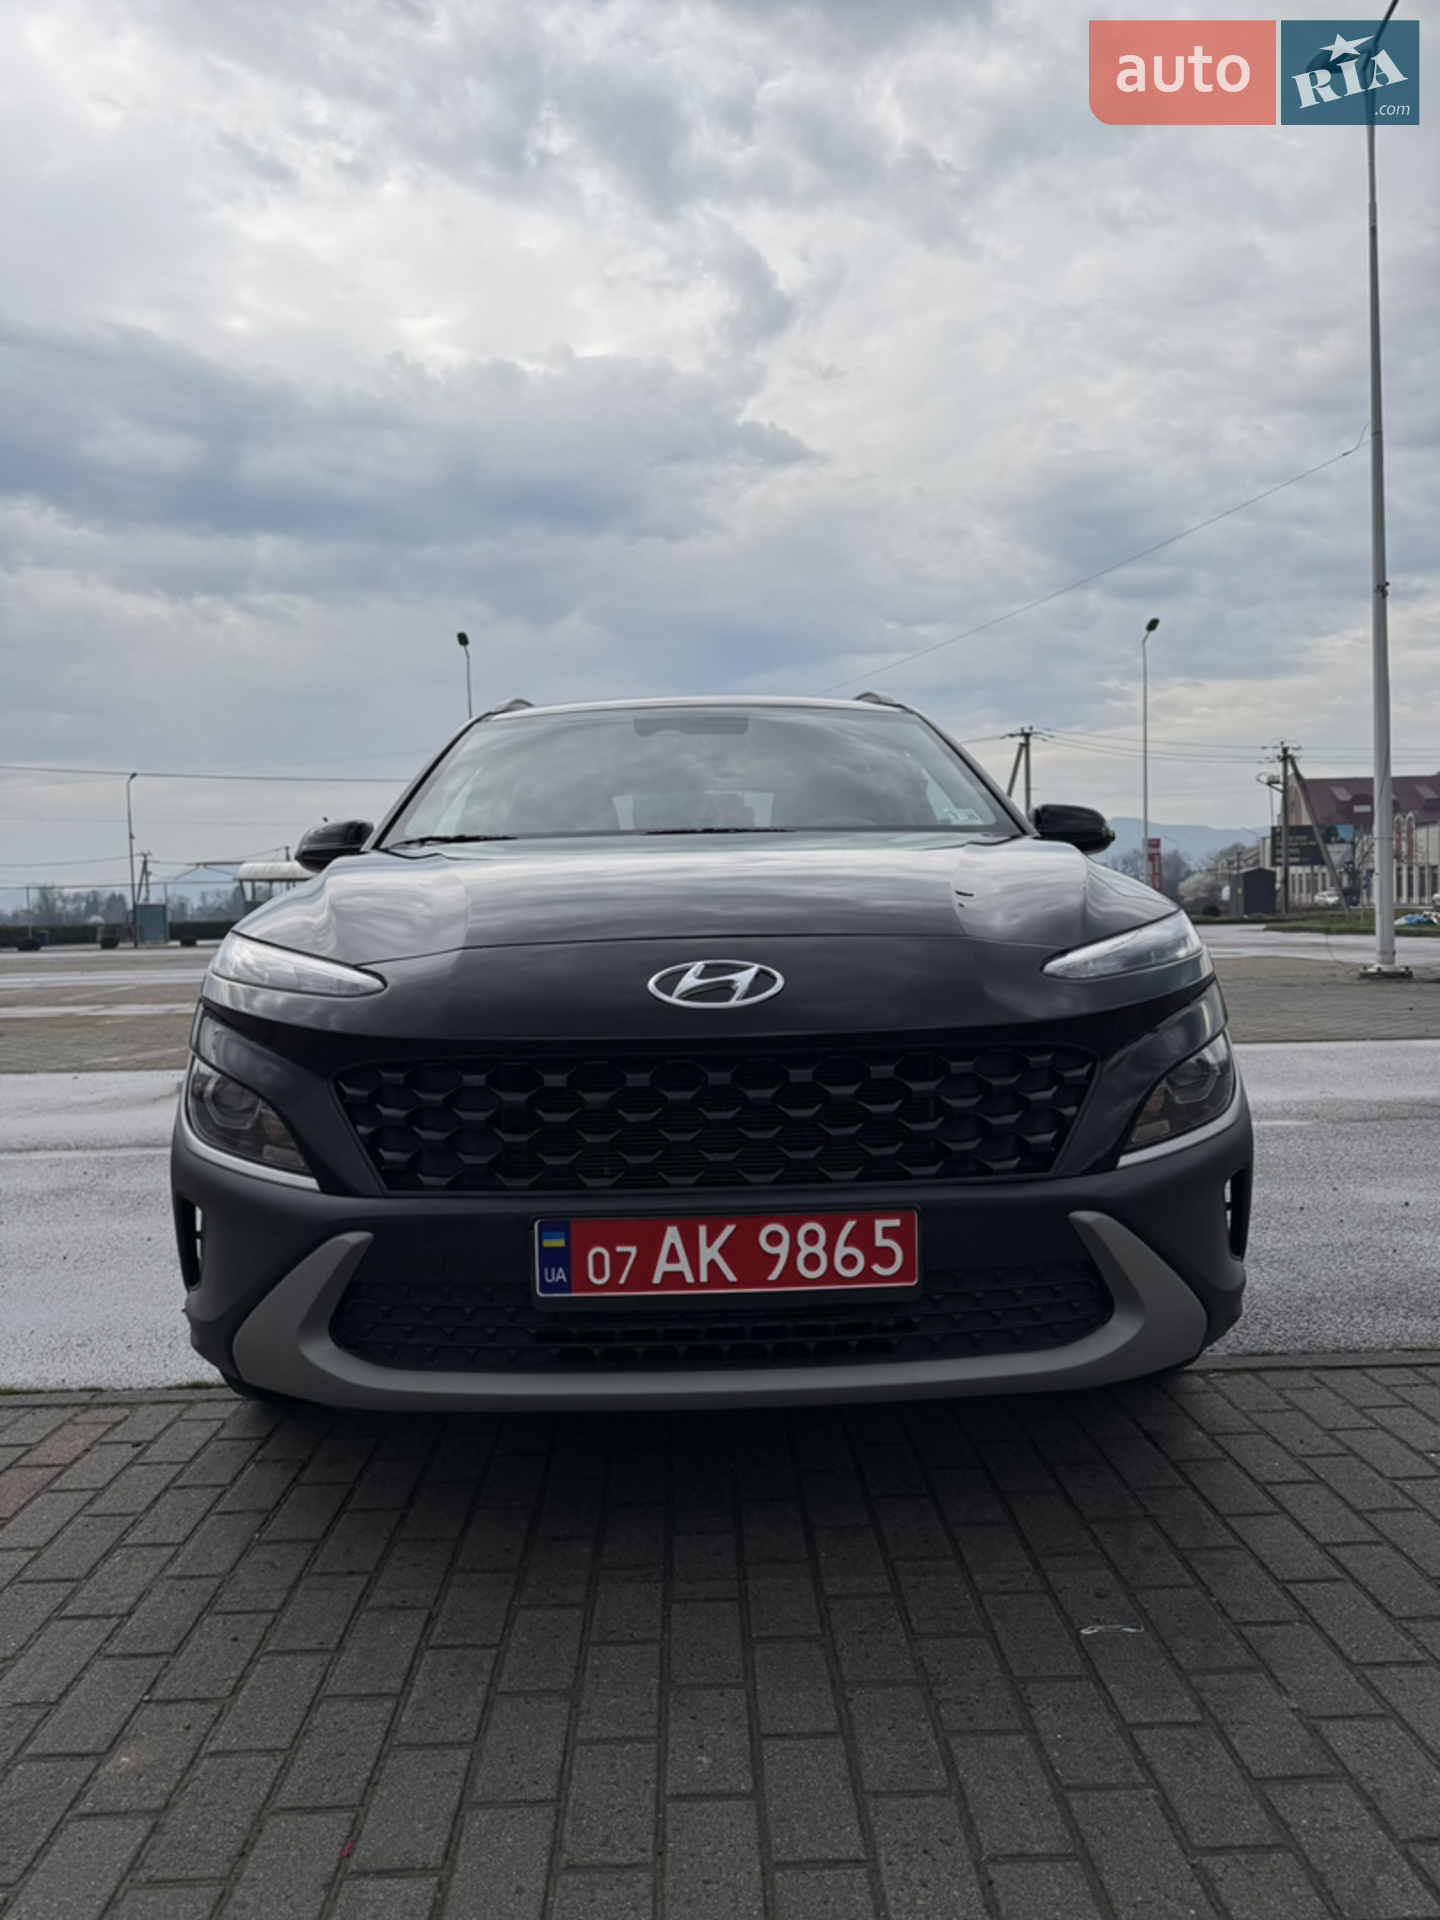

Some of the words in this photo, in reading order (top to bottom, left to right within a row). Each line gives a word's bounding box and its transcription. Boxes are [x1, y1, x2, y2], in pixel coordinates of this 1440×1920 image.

[587, 1246, 638, 1286] 07
[652, 1224, 738, 1285] AK
[758, 1219, 904, 1281] 9865
[544, 1268, 567, 1284] UA
